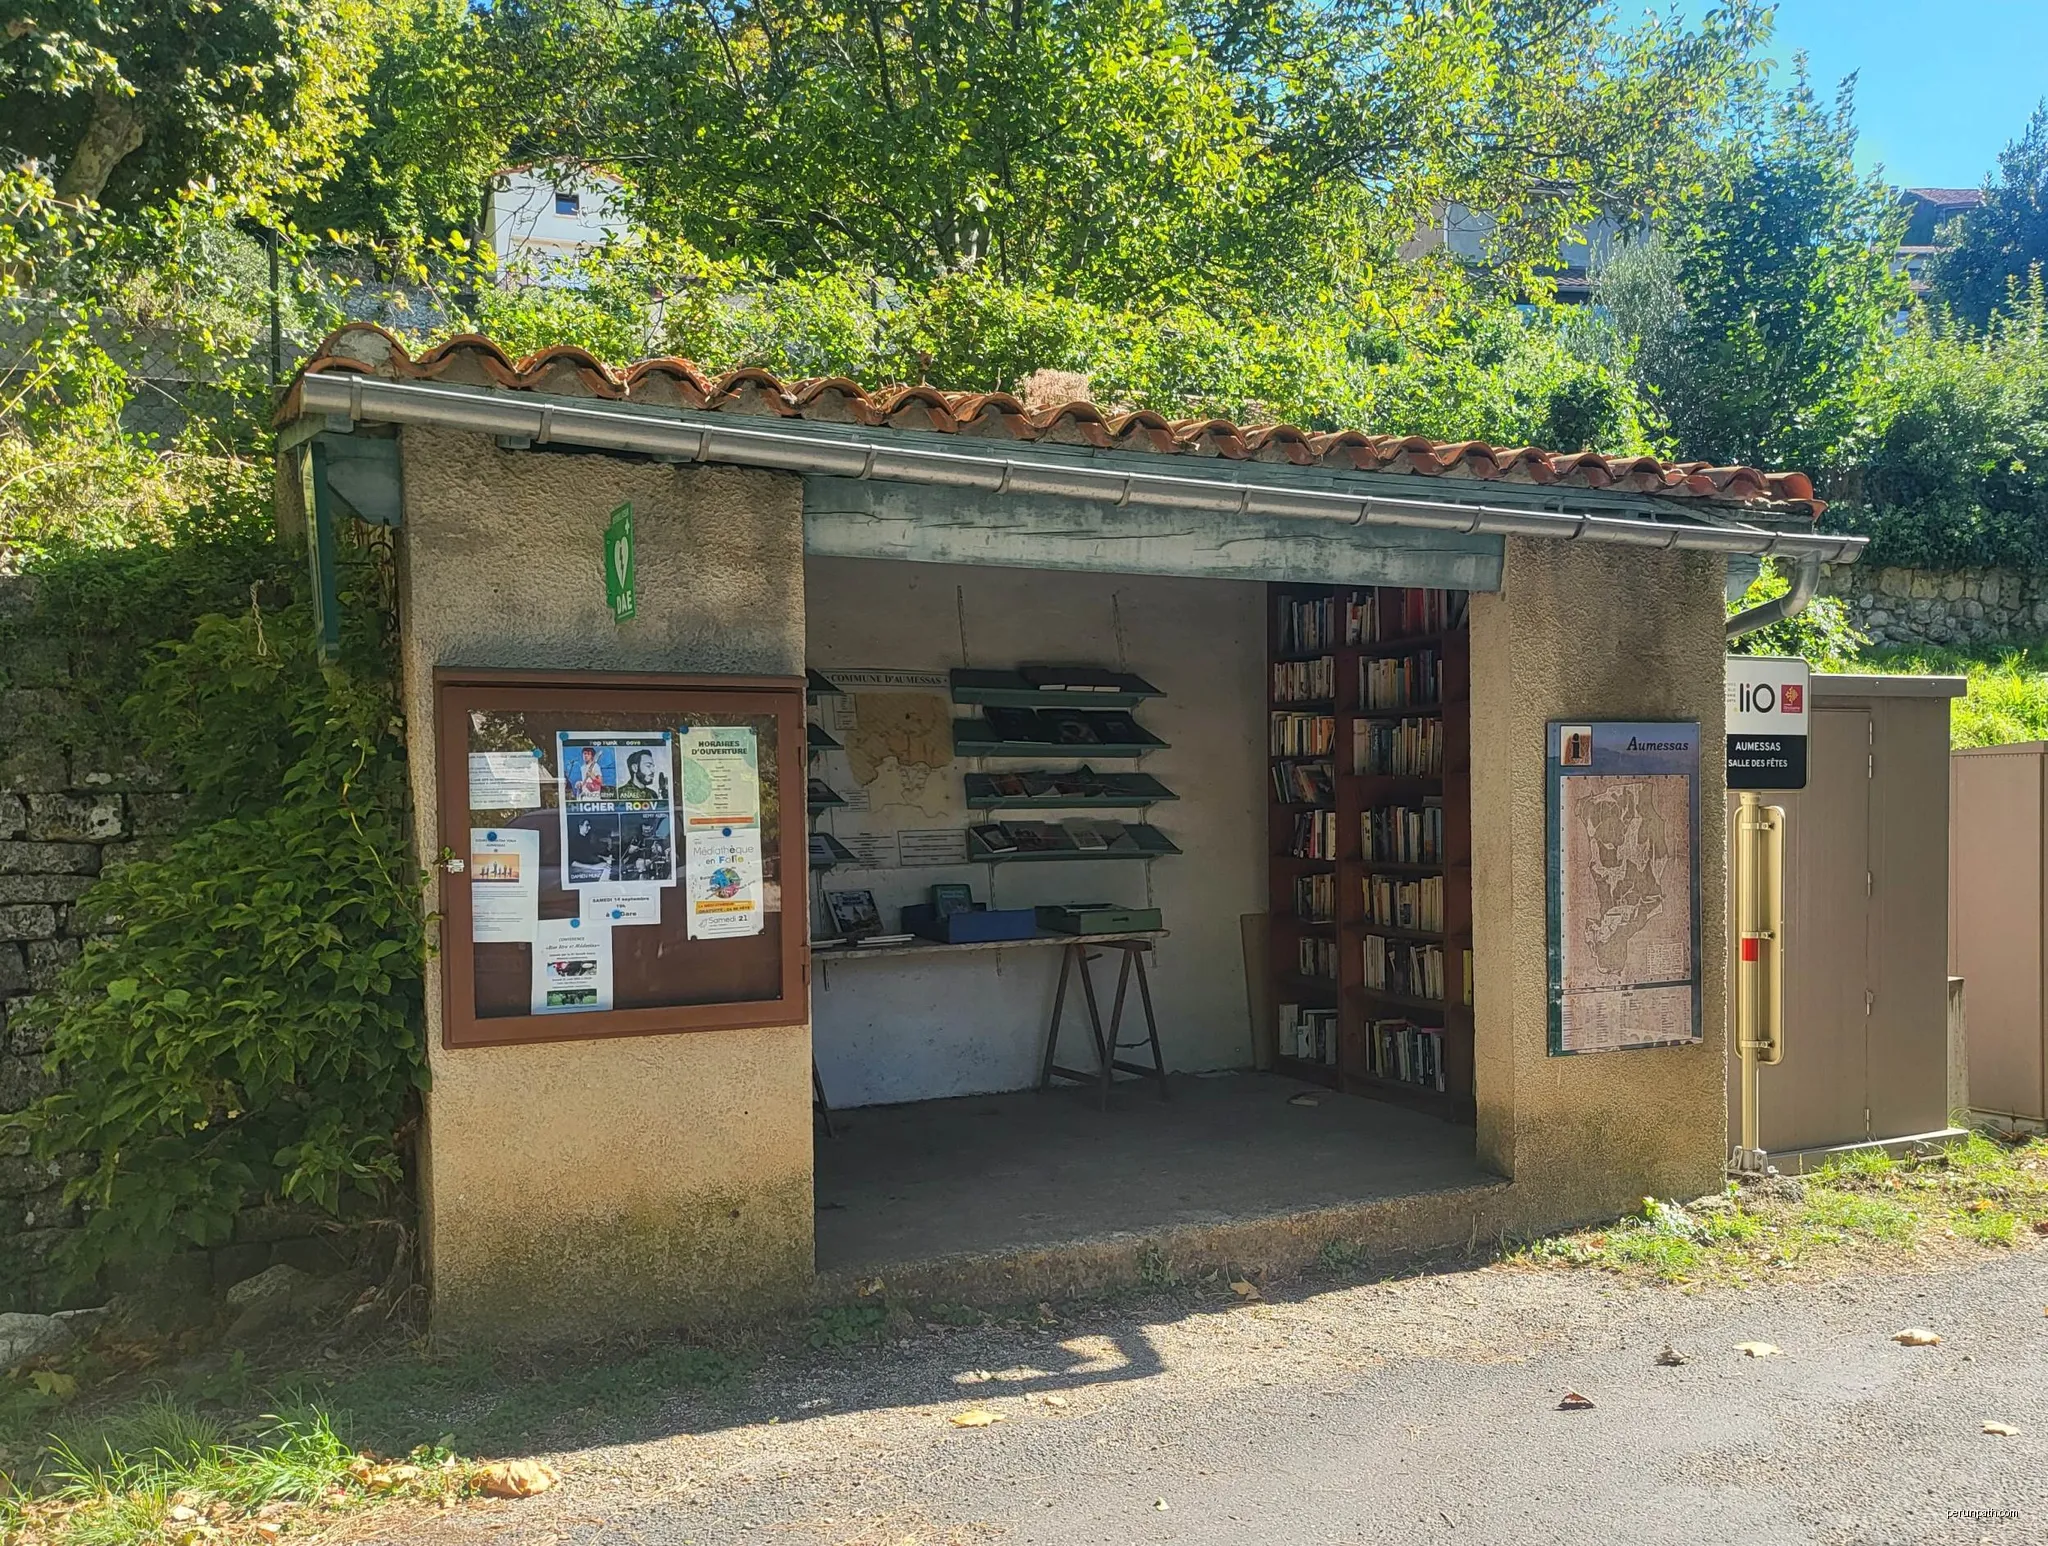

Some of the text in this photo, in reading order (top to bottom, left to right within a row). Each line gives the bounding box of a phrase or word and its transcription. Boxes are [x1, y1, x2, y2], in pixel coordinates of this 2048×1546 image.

[616, 590, 633, 614] DAE
[831, 674, 942, 685] COMMUNE D'AUMESSAS
[1740, 683, 1775, 713] liO
[1626, 736, 1689, 751] Aumessas
[1735, 741, 1781, 751] AUMESSAS
[1728, 757, 1788, 768] SALLE DES FÊTES
[626, 801, 657, 811] ROOV
[693, 846, 754, 855] Médiathèque
[719, 855, 744, 863] Folie
[708, 916, 736, 924] Samedi
